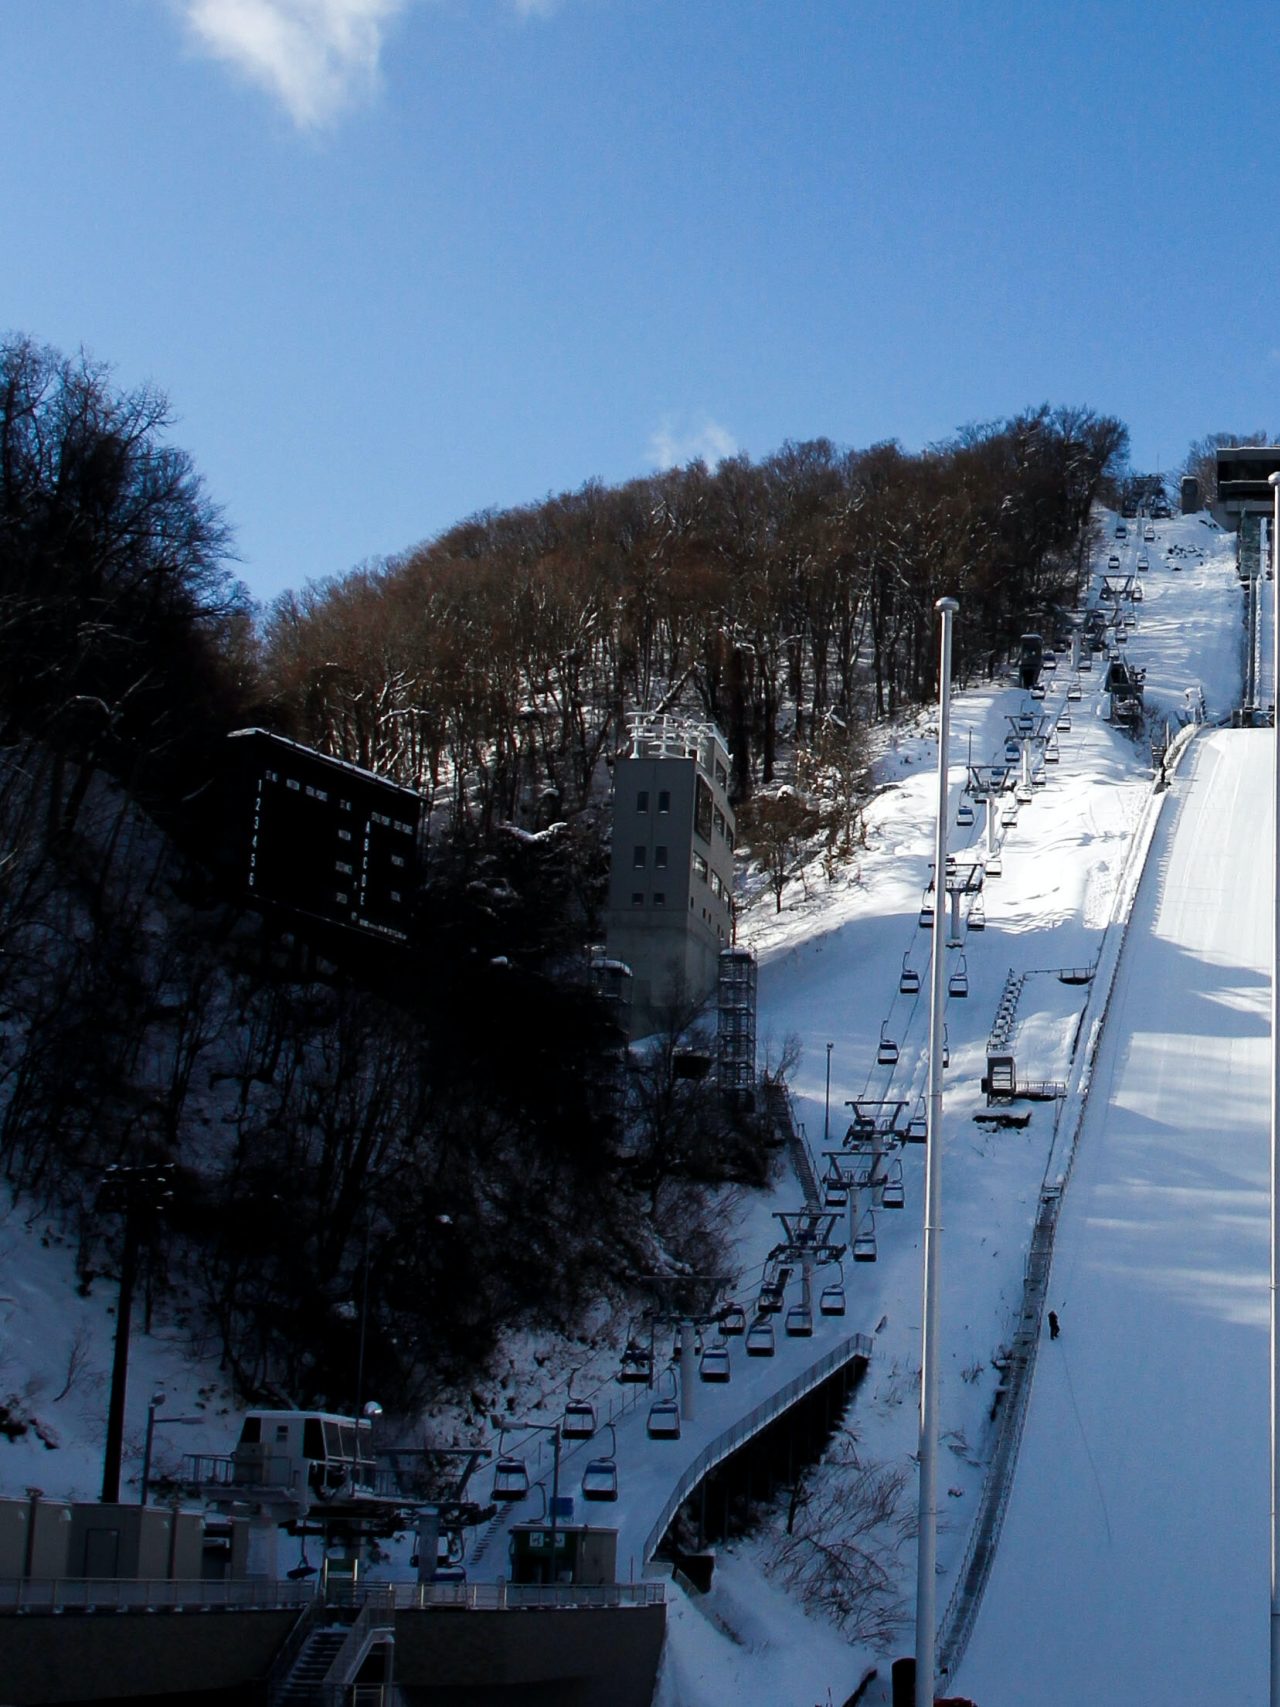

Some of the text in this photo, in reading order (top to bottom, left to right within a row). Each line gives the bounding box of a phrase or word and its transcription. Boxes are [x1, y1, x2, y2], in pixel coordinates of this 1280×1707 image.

[257, 779, 261, 791] 1
[255, 797, 261, 810] 2
[254, 816, 260, 829] 3
[365, 820, 371, 834] A
[252, 834, 257, 848] 4
[251, 853, 256, 867] 5
[362, 856, 367, 869] C
[249, 872, 254, 886] 6
[360, 892, 365, 905] E
